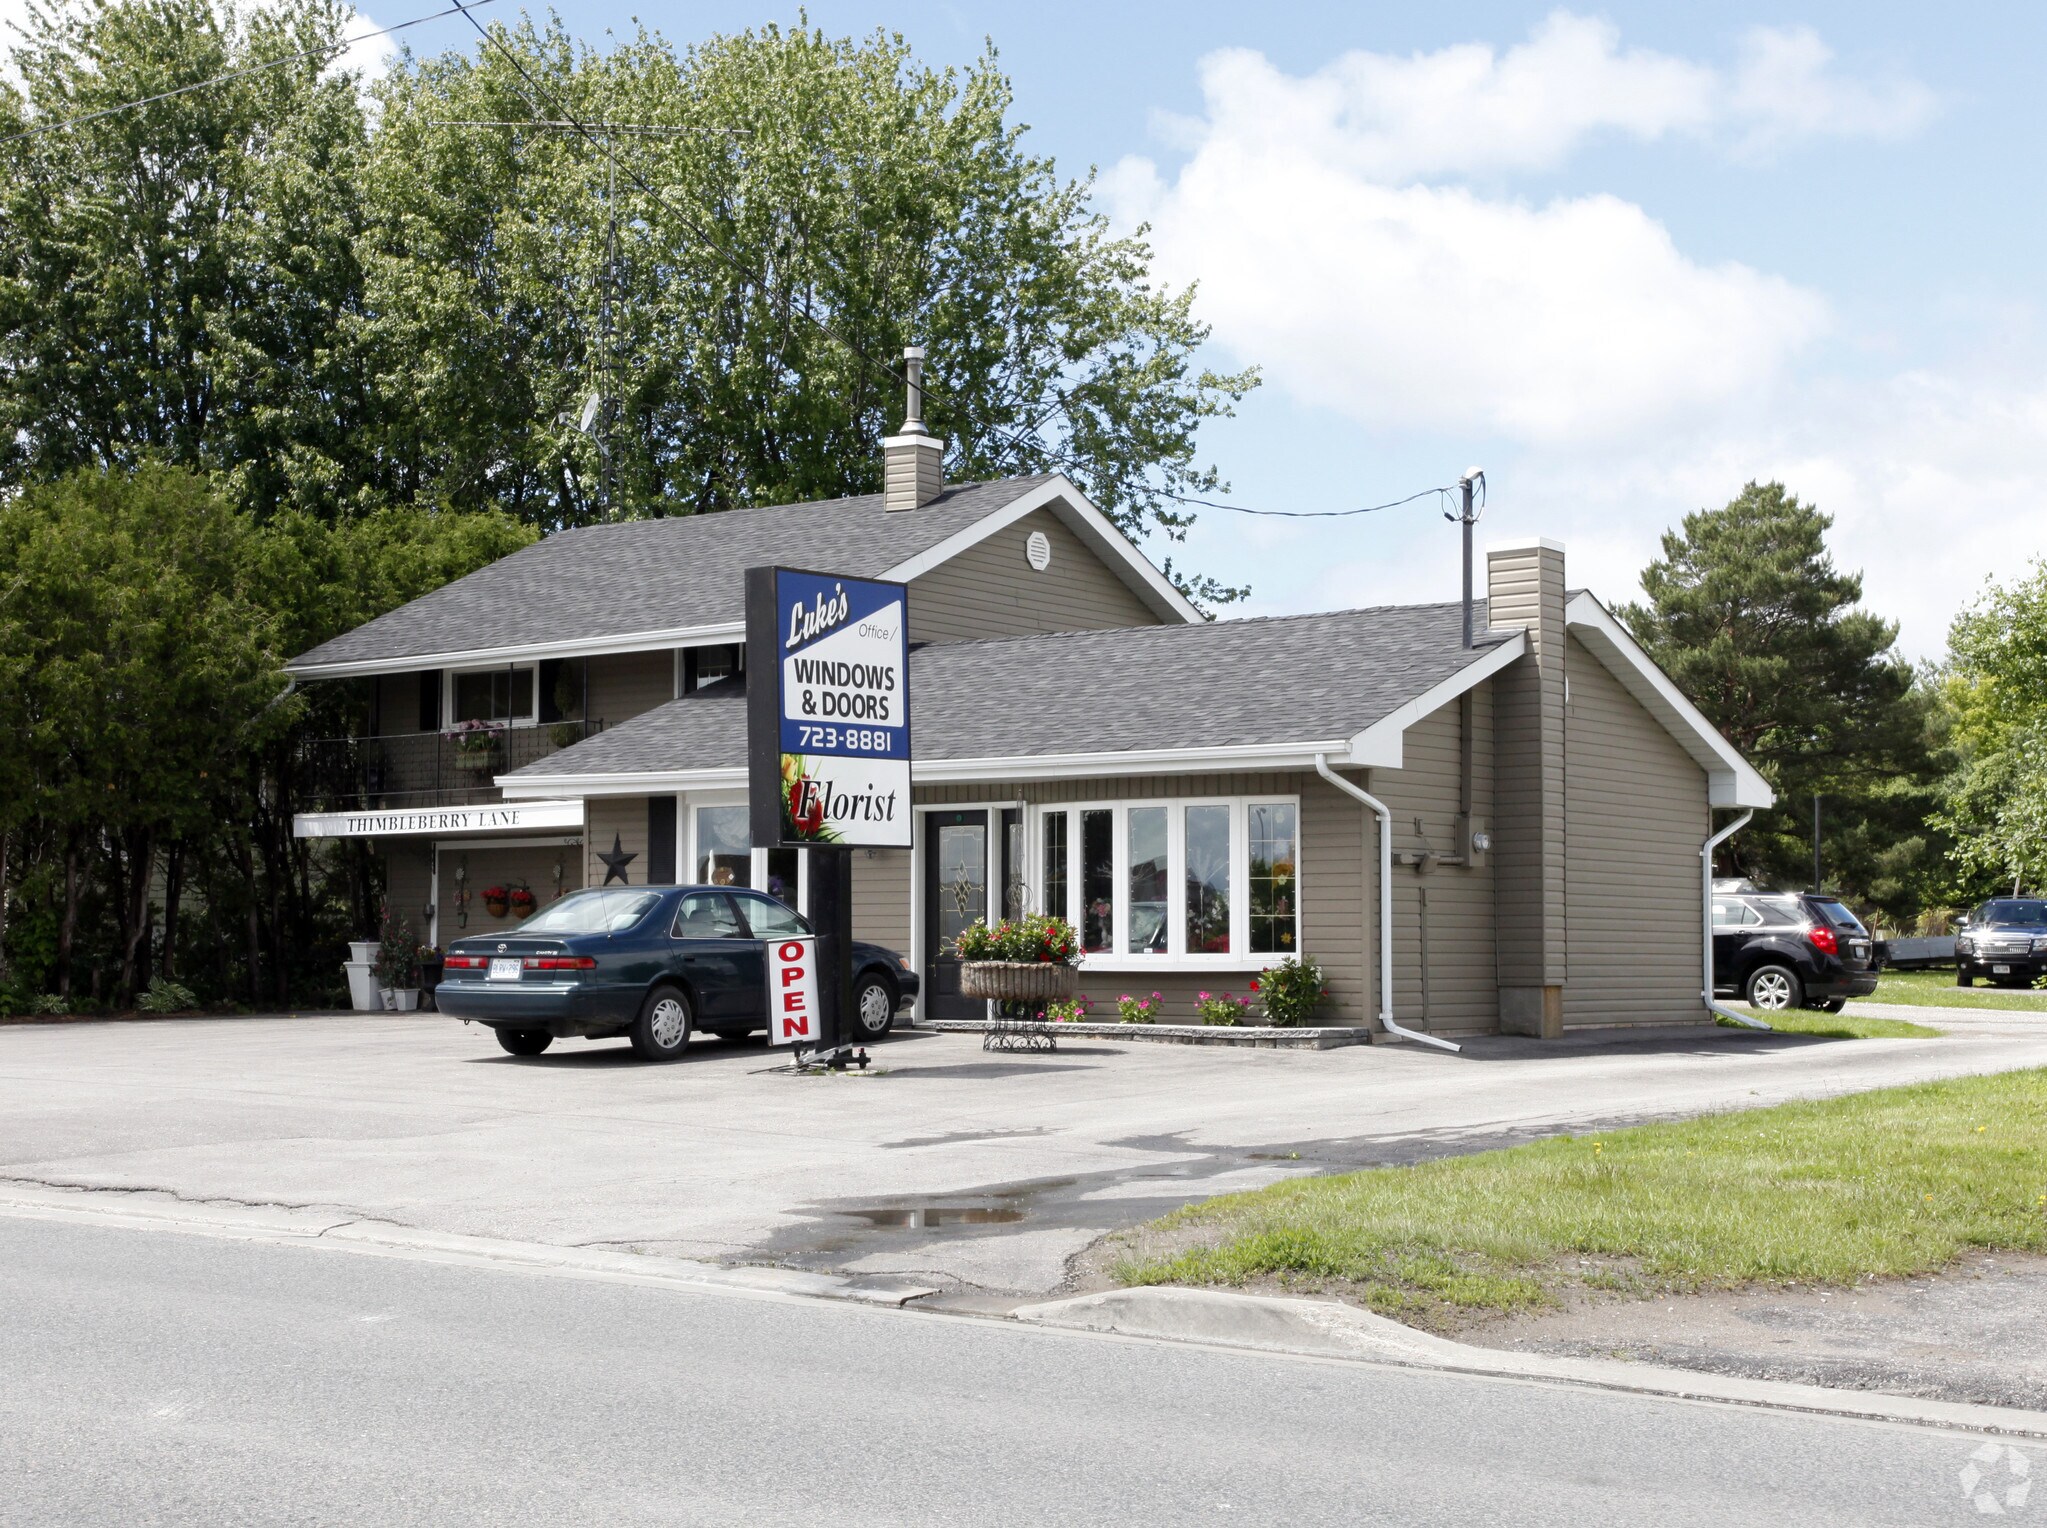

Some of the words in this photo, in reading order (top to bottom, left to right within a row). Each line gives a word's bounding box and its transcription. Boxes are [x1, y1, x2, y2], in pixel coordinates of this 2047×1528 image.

[785, 582, 849, 648] Luke's
[794, 658, 895, 692] WINDOWS
[802, 689, 817, 715] &
[822, 691, 889, 720] DOORS
[799, 726, 891, 752] 723-8881
[797, 779, 896, 822] Florist
[347, 813, 472, 832] THIMBLEBERRY
[479, 810, 520, 827] LANE
[778, 941, 809, 1037] OPEN
